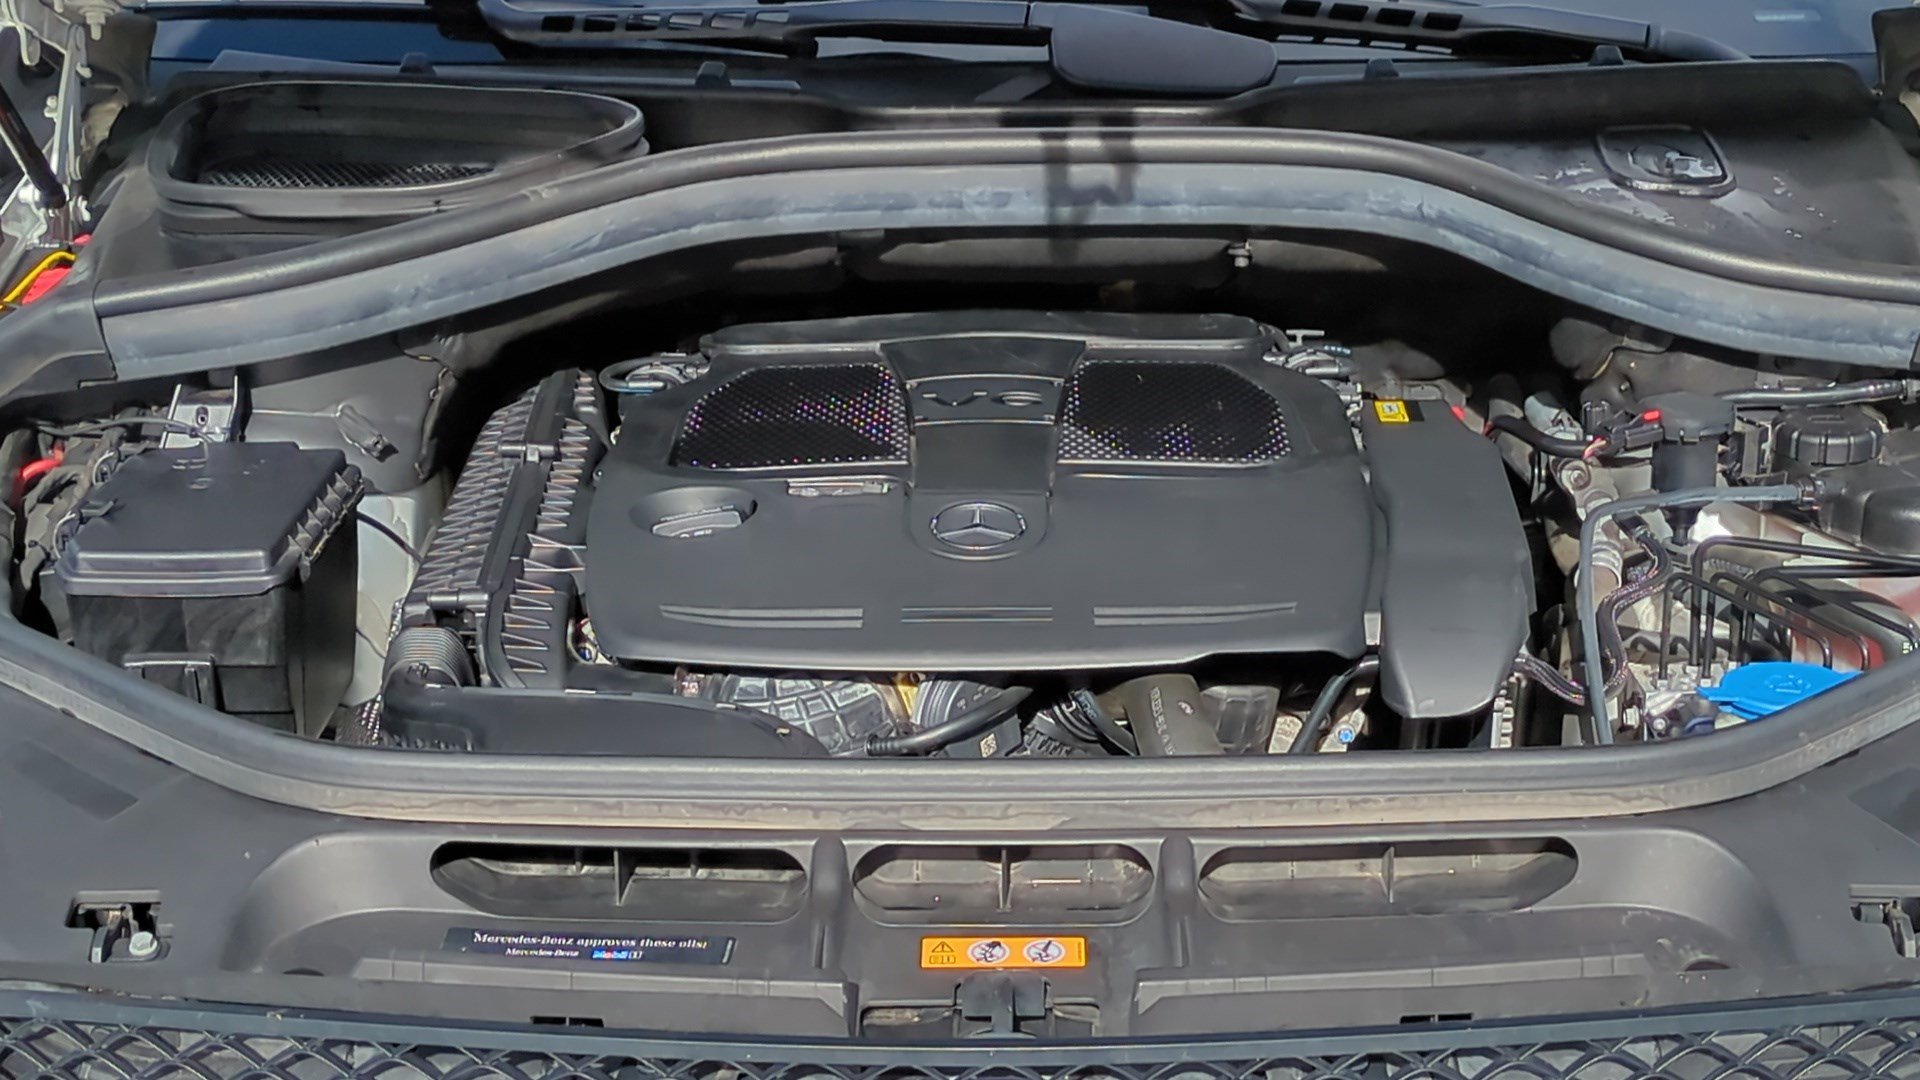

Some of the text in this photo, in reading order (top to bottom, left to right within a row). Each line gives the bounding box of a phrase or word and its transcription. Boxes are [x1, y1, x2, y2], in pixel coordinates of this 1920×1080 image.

[473, 931, 574, 946] Mercedes-Benz
[576, 937, 637, 948] approves
[639, 938, 676, 949] these
